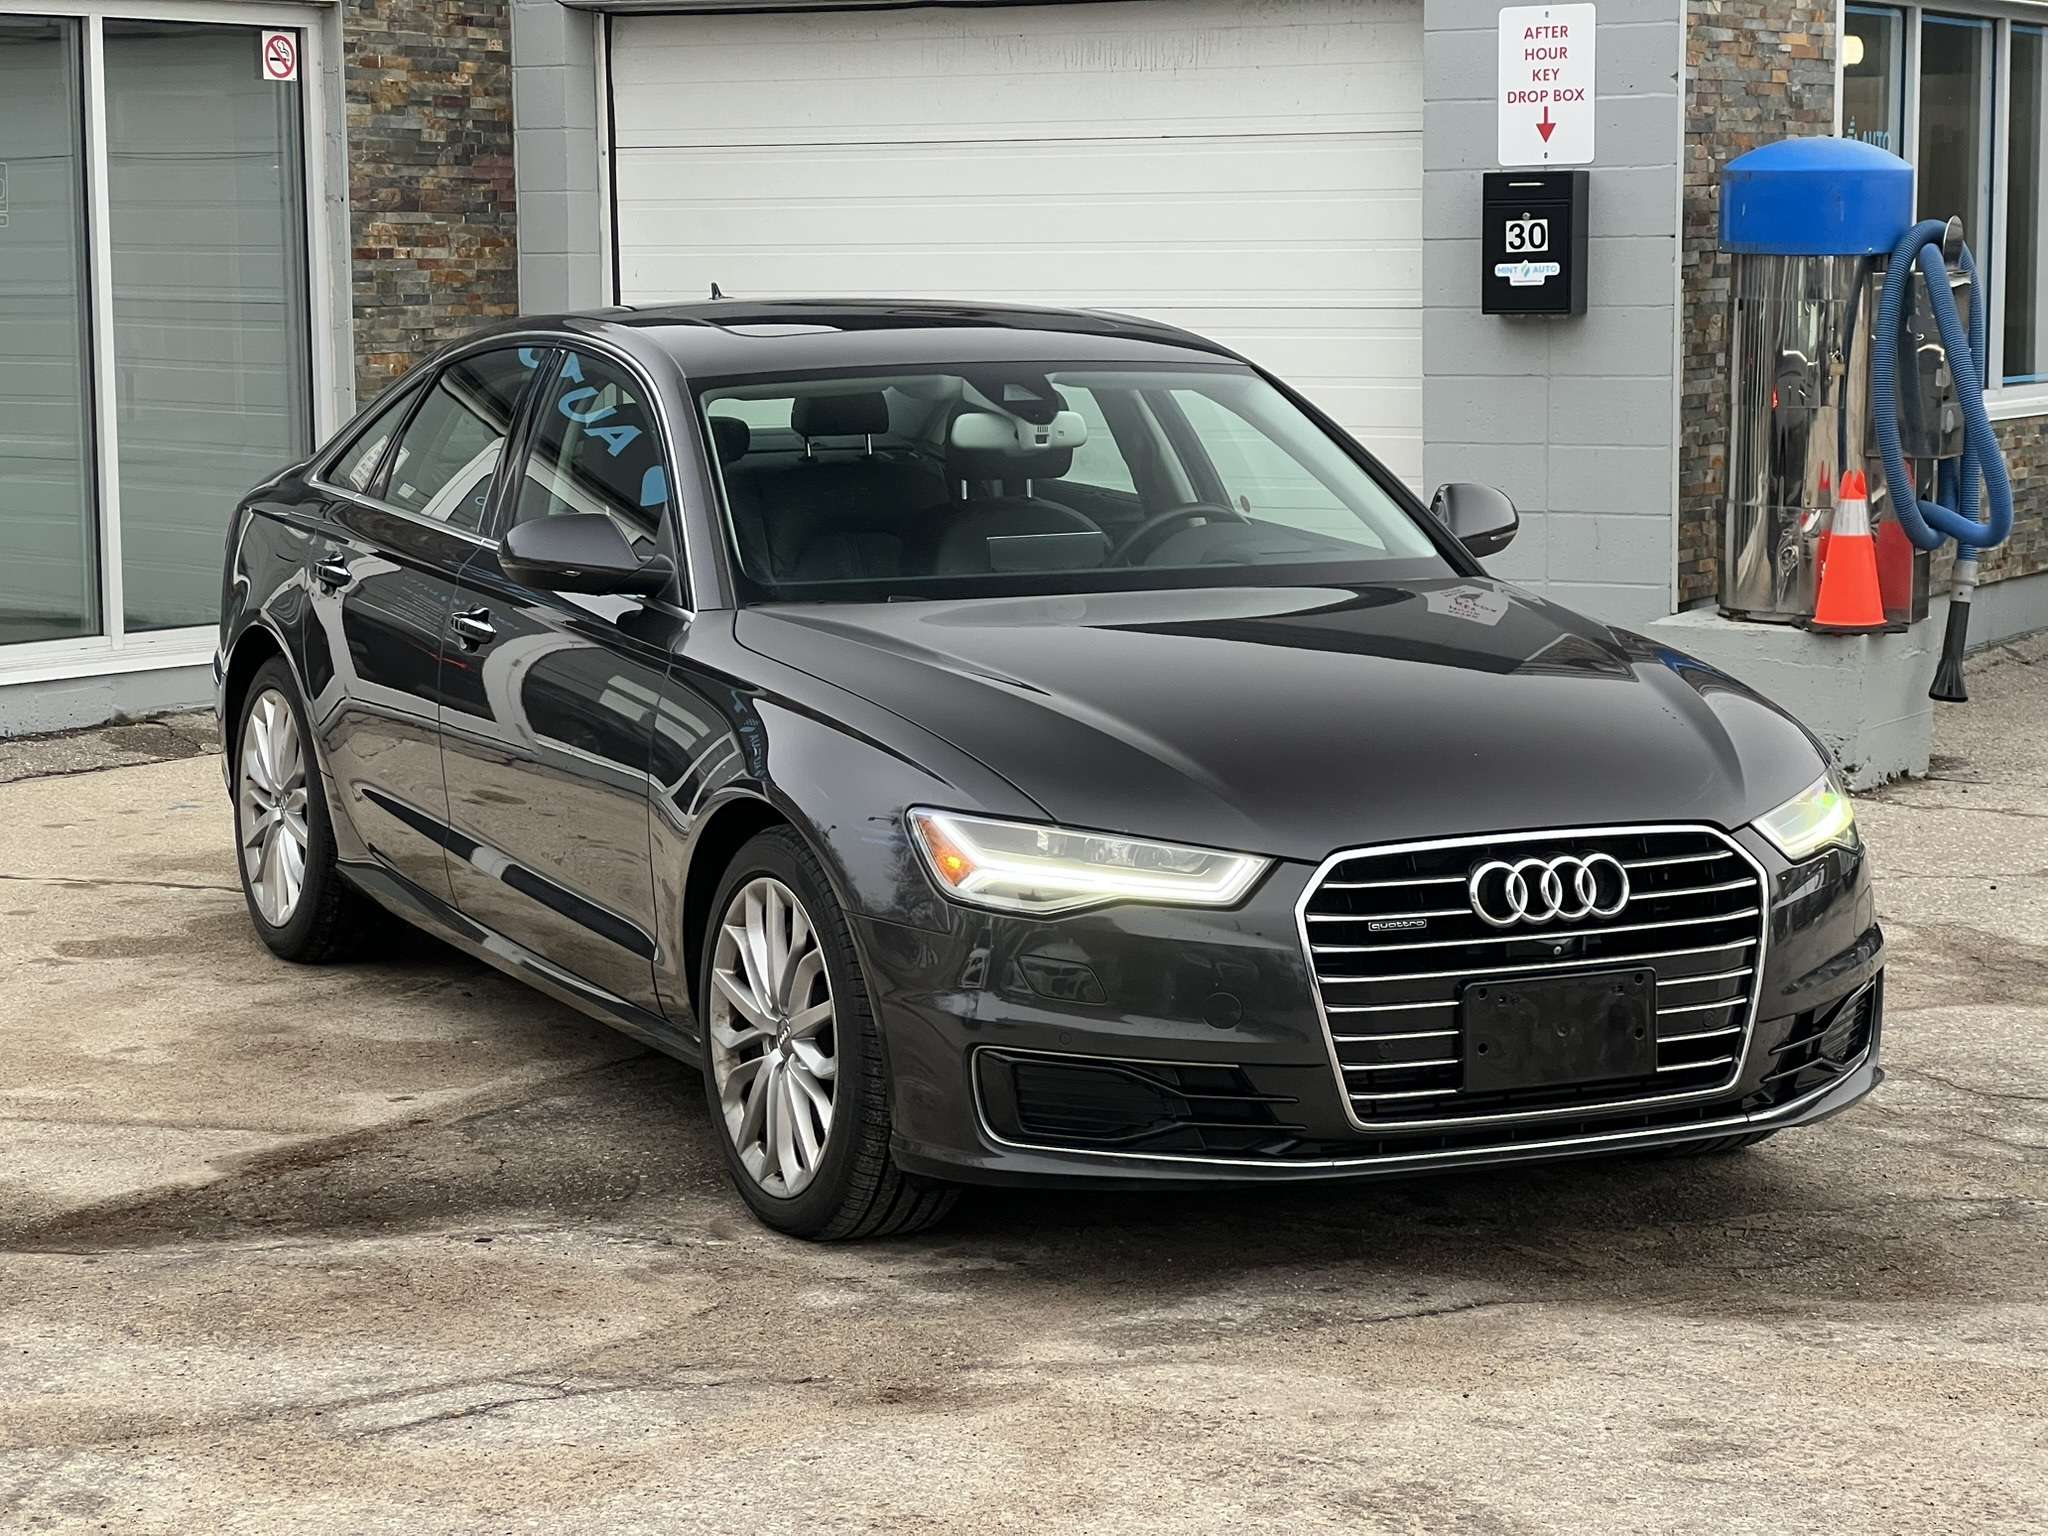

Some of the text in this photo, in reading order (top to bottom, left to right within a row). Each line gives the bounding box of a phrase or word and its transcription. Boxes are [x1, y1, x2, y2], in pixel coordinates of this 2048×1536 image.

[1524, 25, 1568, 40] AFTER
[1525, 46, 1568, 61] HOUR
[1532, 68, 1560, 82] KEY
[1507, 88, 1585, 104] DROP BOX
[1508, 222, 1546, 250] 30
[1497, 265, 1558, 275] MINT AUTO
[1371, 920, 1425, 930] quattro
